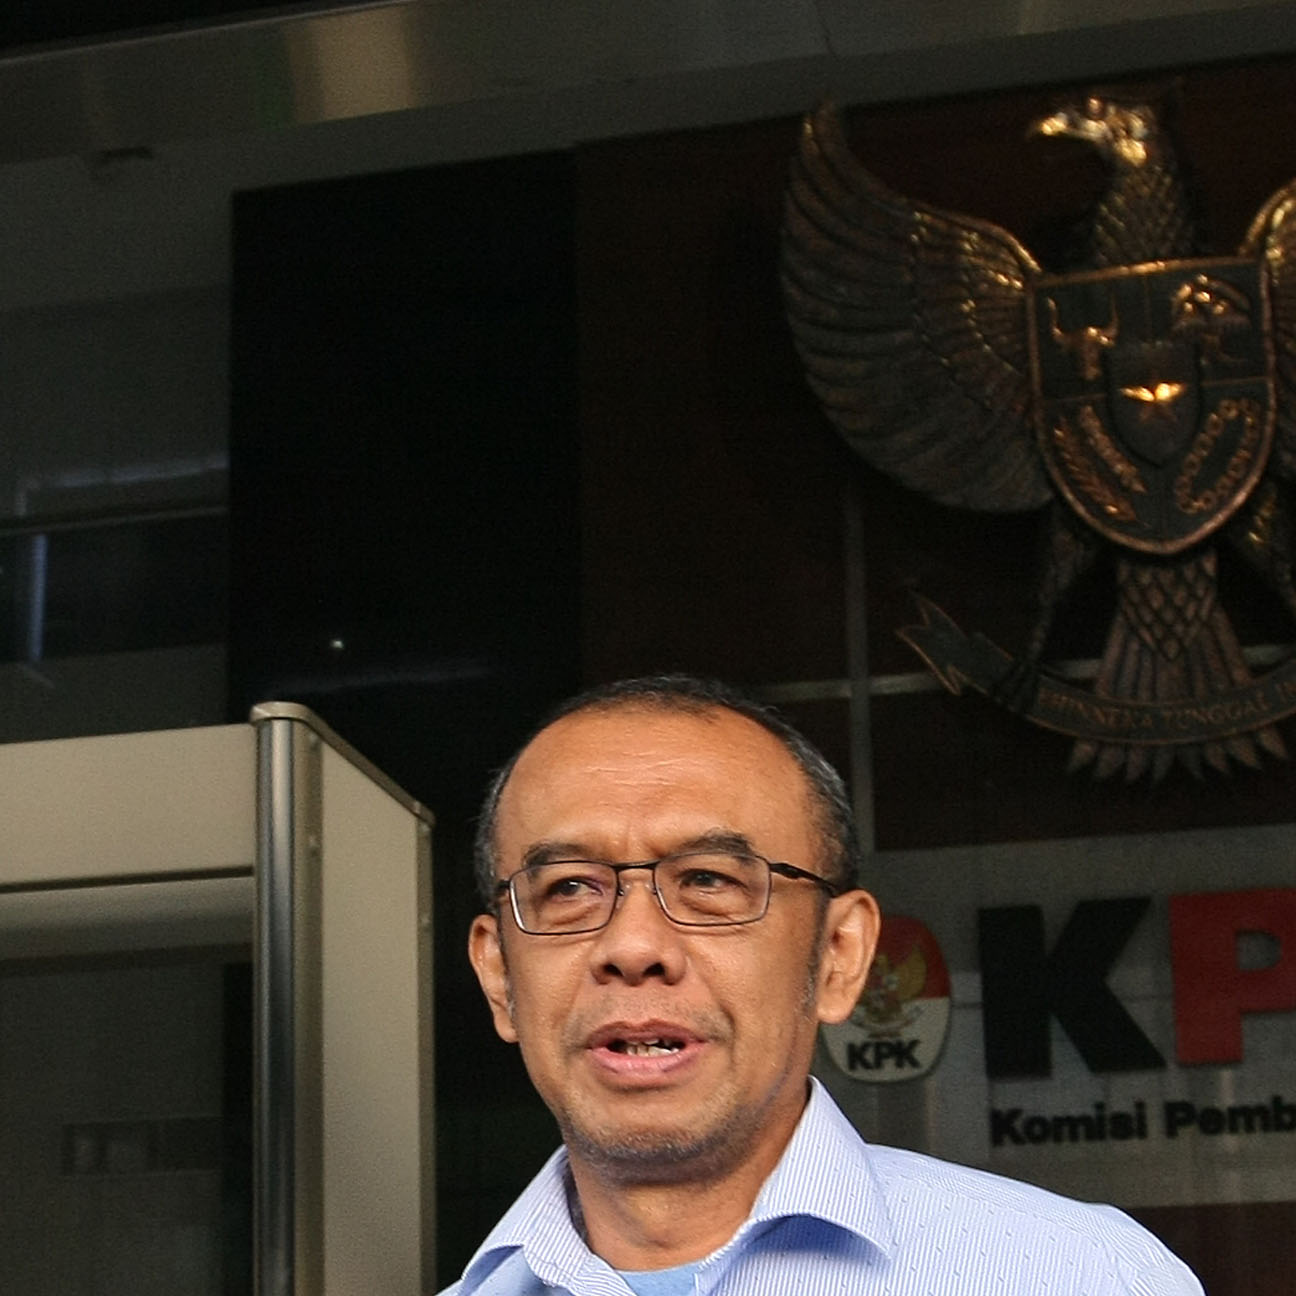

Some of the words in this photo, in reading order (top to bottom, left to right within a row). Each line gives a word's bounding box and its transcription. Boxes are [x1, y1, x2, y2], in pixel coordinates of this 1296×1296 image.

[1162, 689, 1273, 730] TUNGGAL
[847, 1039, 921, 1072] KPK
[990, 1101, 1148, 1147] Komisi
